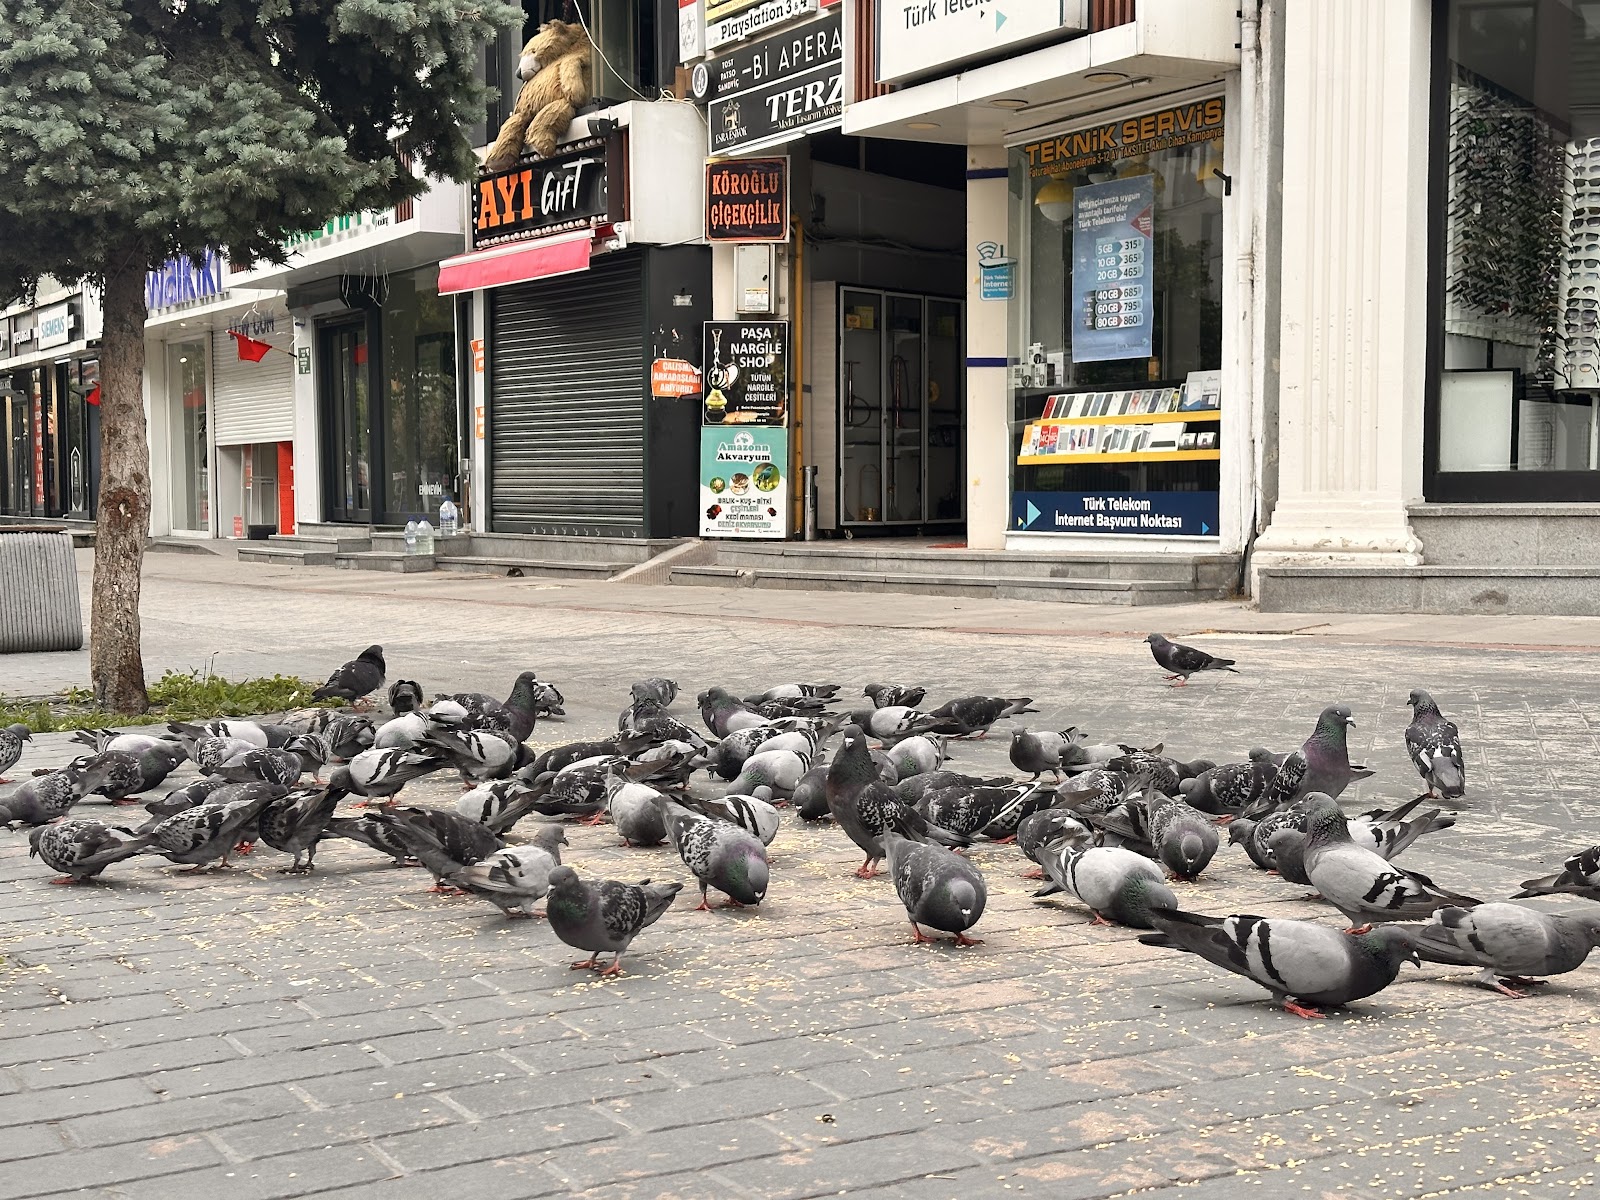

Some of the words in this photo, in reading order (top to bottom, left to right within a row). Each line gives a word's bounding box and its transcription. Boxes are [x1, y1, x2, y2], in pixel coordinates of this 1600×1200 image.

[721, 6, 783, 40] Playstation
[904, 5, 936, 29] Türk
[722, 58, 734, 69] TOST
[720, 69, 736, 81] PATSO
[718, 78, 739, 92] SANDVİÇ
[711, 170, 779, 195] KÖROĞLU
[478, 169, 534, 230] AYI
[1119, 192, 1140, 203] uygun
[711, 199, 781, 230] ÇİÇEKÇİLİK
[1103, 204, 1128, 214] tarifeler
[1078, 219, 1091, 228] Türk
[1098, 245, 1103, 255] 5
[1103, 244, 1113, 253] GB
[1124, 240, 1138, 250] 315
[1098, 258, 1105, 267] 10
[1106, 257, 1116, 266] GB
[1124, 254, 1138, 264] 365
[1098, 271, 1107, 280] 20
[1107, 270, 1118, 279] GB
[1123, 267, 1138, 277] 465
[1098, 291, 1107, 300] 40
[1108, 289, 1119, 299] GB
[1123, 288, 1138, 297] 685
[1098, 304, 1107, 314] 60
[1108, 303, 1118, 312] GB
[1124, 302, 1137, 311] 795
[1098, 318, 1107, 327] 80
[1108, 316, 1118, 326] GB
[1123, 315, 1138, 325] 860
[41, 316, 65, 339] SIEMENS
[741, 327, 772, 341] PAŞA
[730, 341, 782, 354] NARGİLE
[740, 356, 775, 368] SHOP
[750, 372, 772, 382] TÜTÜN
[747, 383, 775, 391] NARGİLE
[745, 392, 777, 402] ÇEŞİTLERİ
[719, 443, 769, 452] Amazonn
[717, 453, 770, 461] Akvaryum
[717, 497, 735, 505] BALIK
[740, 497, 752, 506] KUŞ
[757, 497, 772, 505] BİTKİ
[1082, 497, 1106, 511] Türk
[1106, 497, 1151, 511] Telekom
[1055, 510, 1094, 527] İnternet
[1096, 513, 1138, 531] Başvuru
[1140, 513, 1182, 528] Noktası
